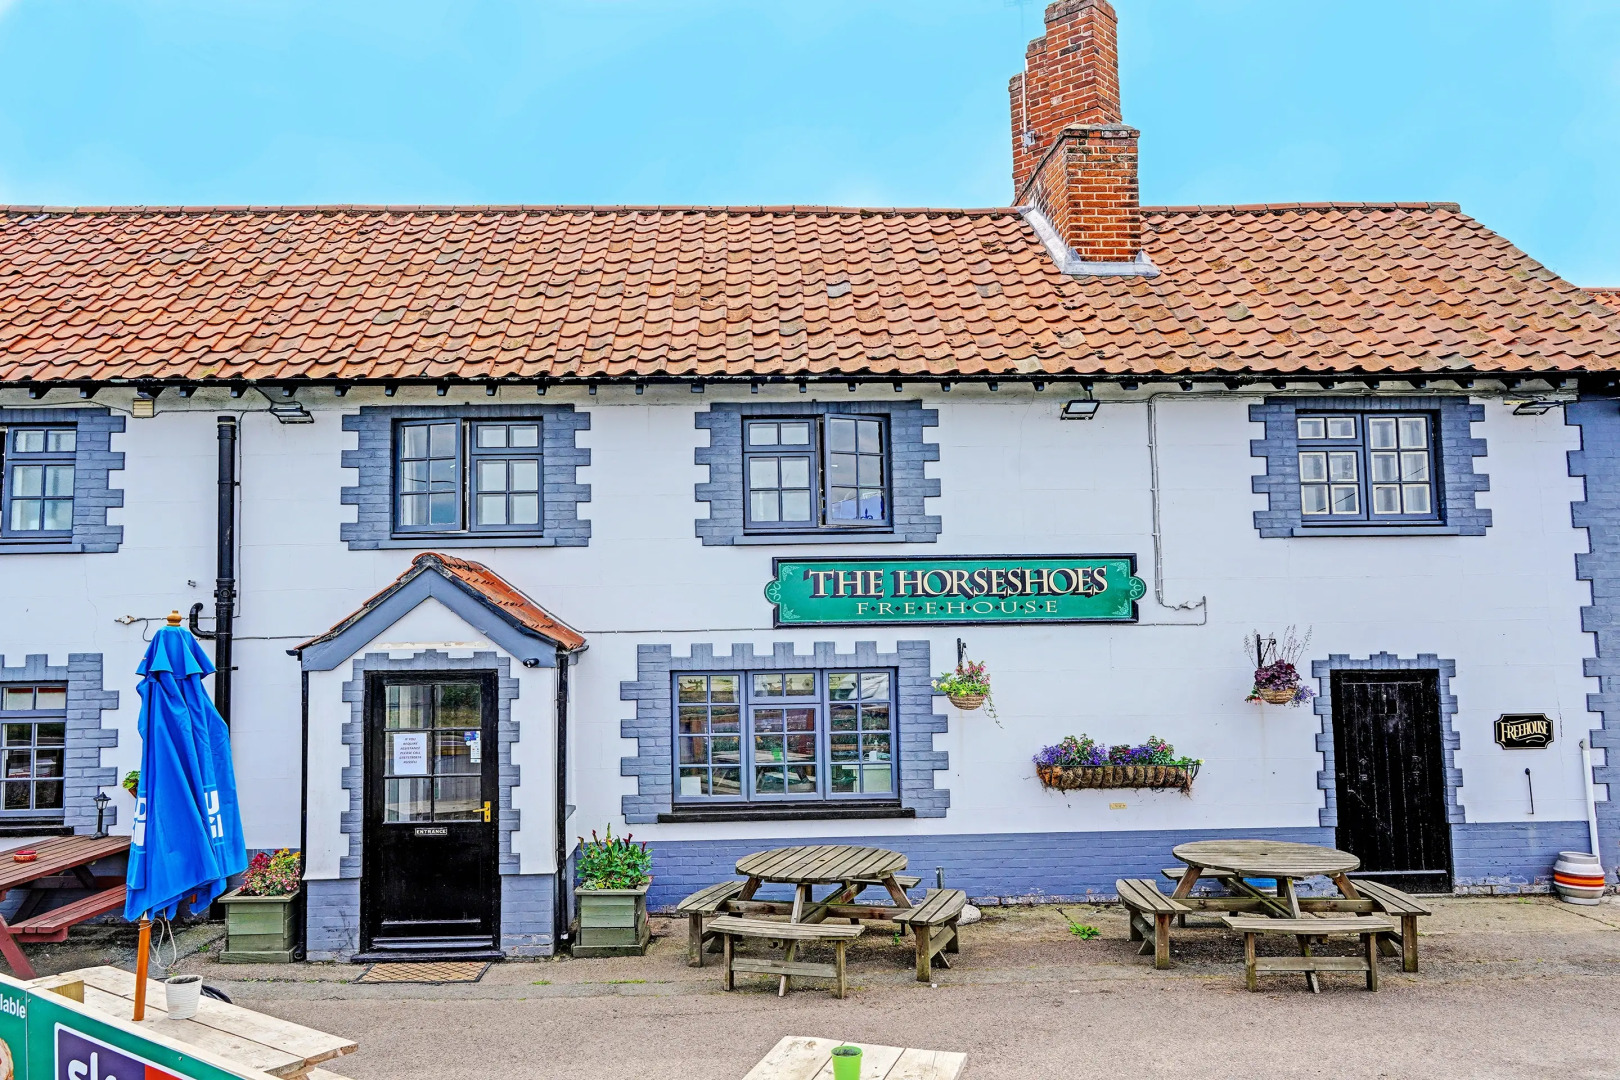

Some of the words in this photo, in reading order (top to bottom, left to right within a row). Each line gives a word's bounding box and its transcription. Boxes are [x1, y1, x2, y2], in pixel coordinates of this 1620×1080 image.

[804, 568, 884, 599] THE
[891, 565, 1108, 599] HORSESHOES
[1500, 720, 1549, 742] FREEHOUSE
